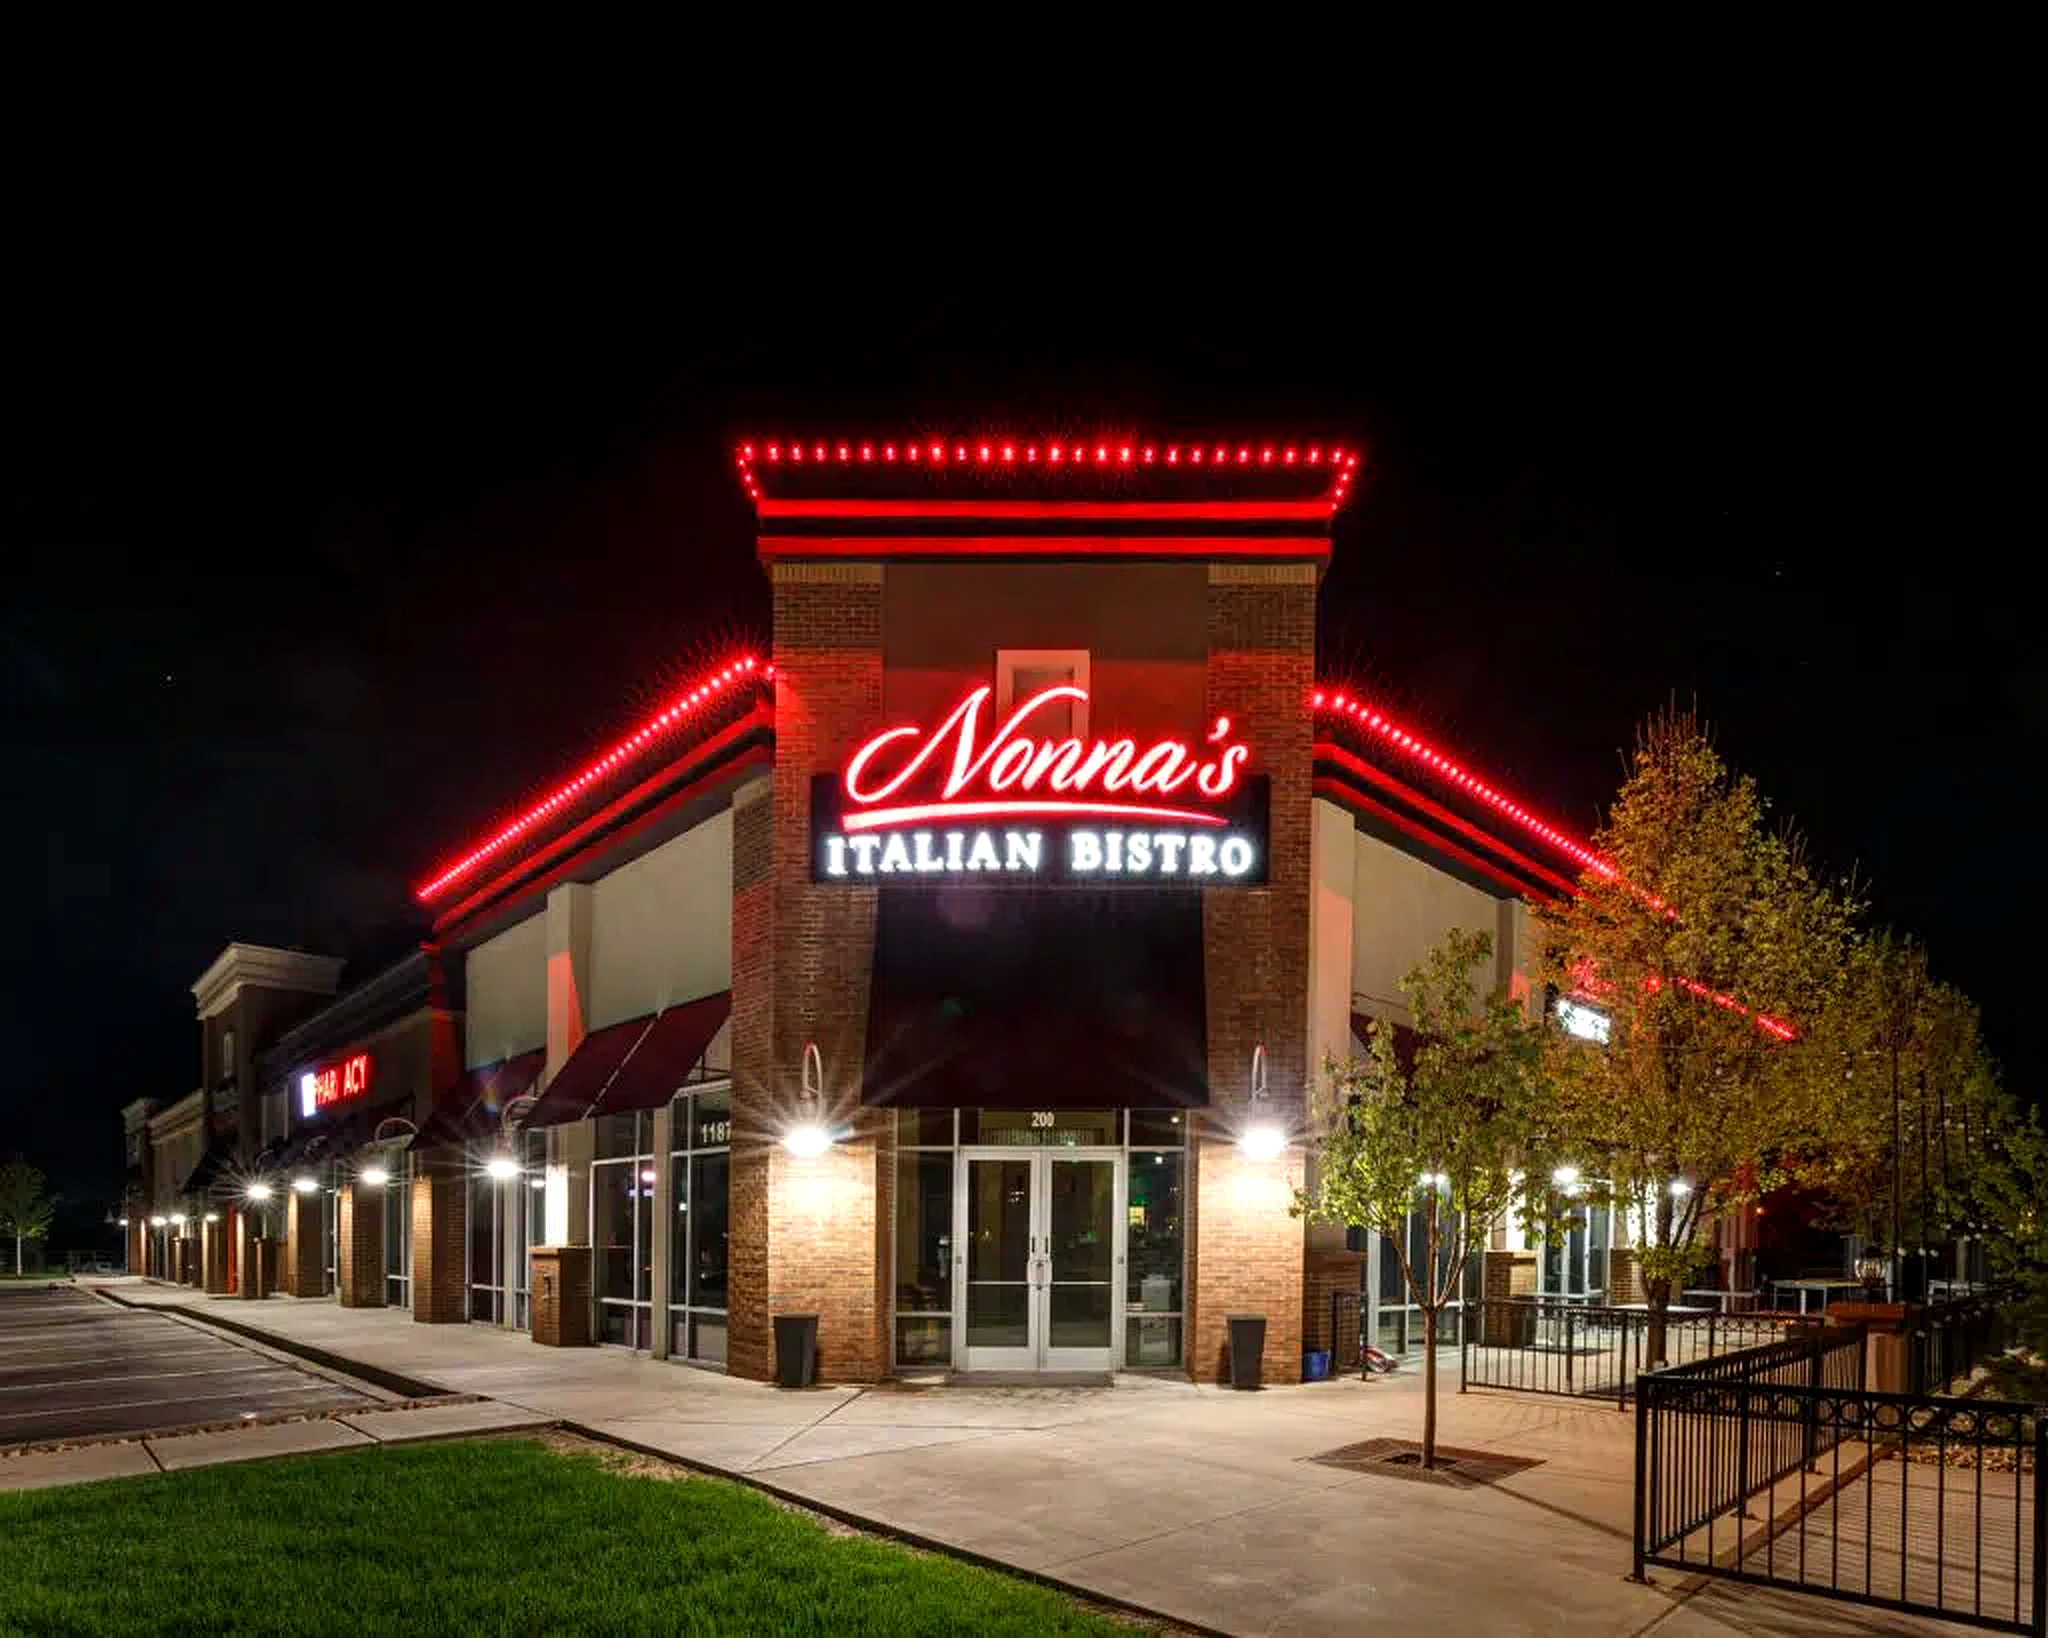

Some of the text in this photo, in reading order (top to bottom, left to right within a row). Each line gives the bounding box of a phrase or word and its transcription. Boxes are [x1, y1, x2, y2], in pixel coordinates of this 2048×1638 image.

[846, 686, 1248, 803] Nonna's
[826, 832, 1253, 877] ITALIAN BISTRO
[313, 1054, 368, 1105] PHARACY
[1031, 1111, 1055, 1127] 200
